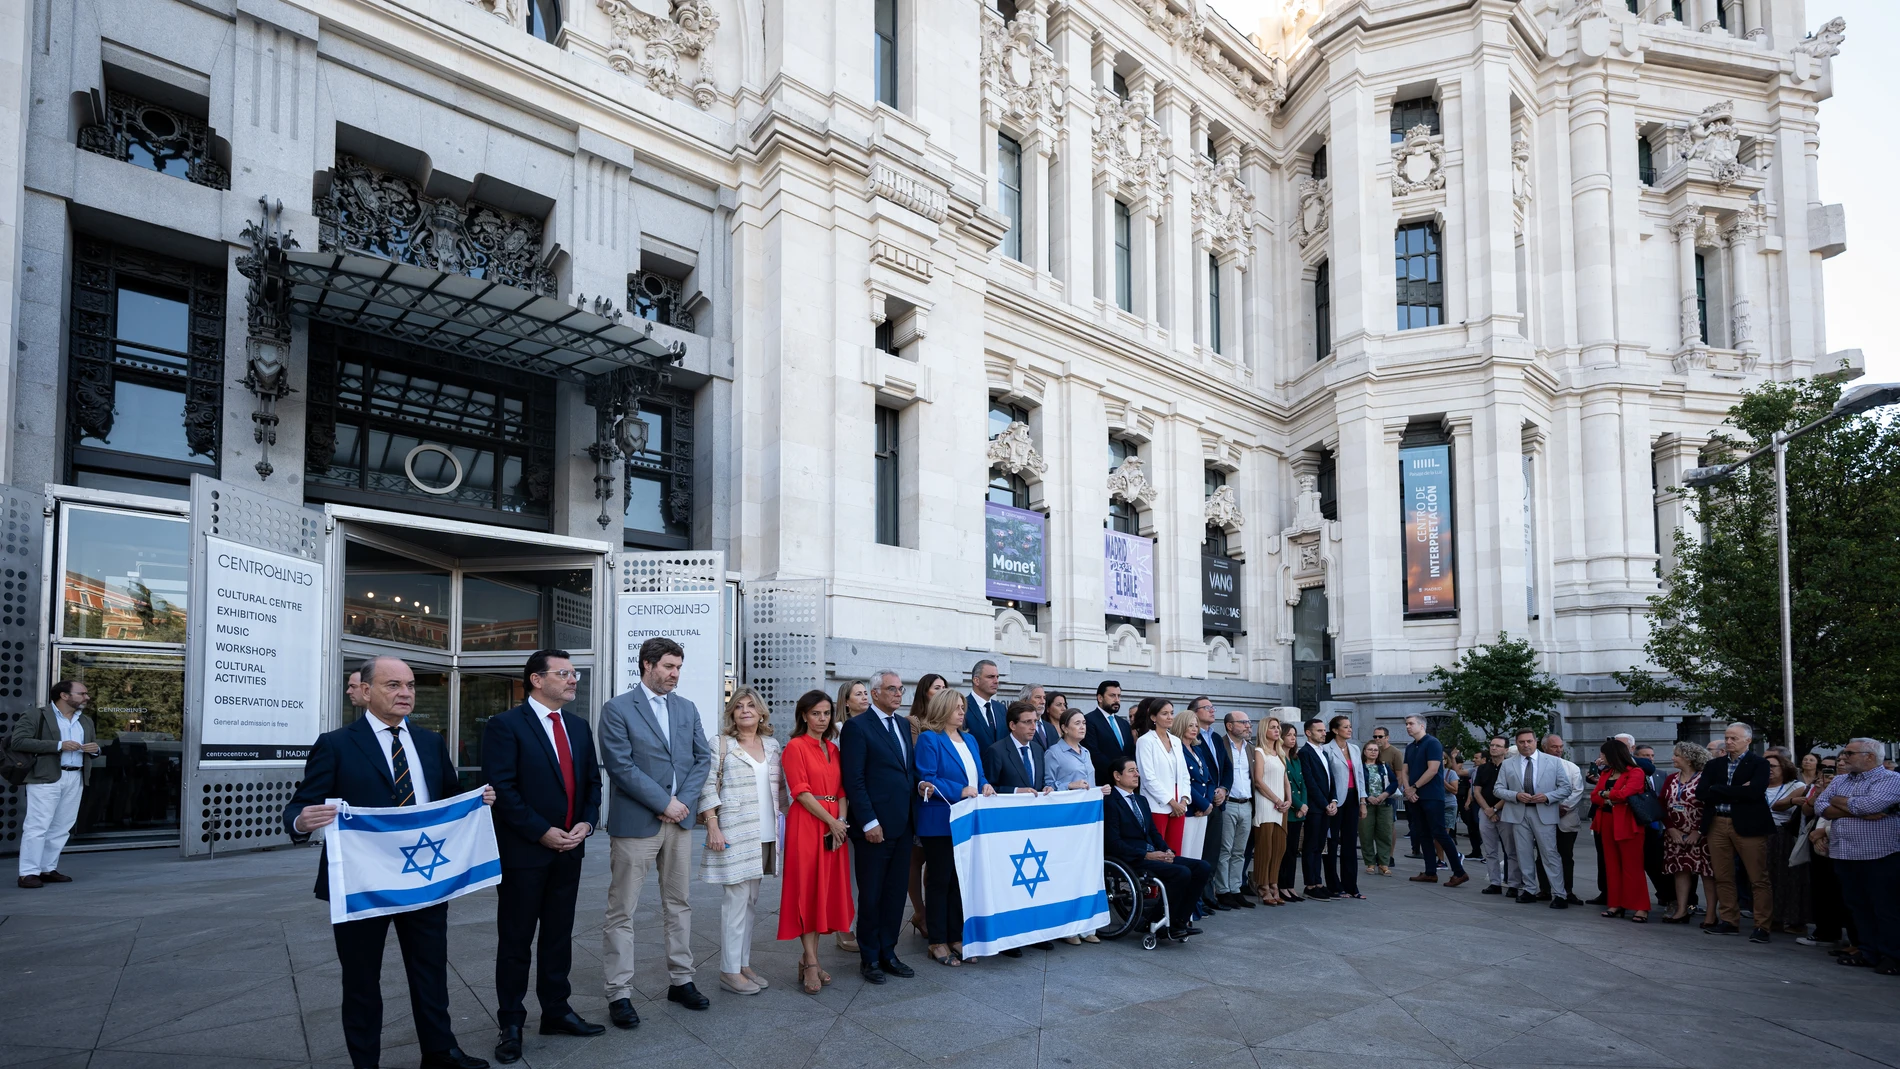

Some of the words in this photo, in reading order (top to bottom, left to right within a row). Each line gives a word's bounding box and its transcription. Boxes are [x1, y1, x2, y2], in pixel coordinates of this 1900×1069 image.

[1416, 486, 1426, 500] DE
[1416, 502, 1427, 542] CENTRO
[1426, 485, 1440, 578] INTERPRETACIÓN
[1105, 534, 1127, 561] MADRID
[992, 553, 1036, 574] Monet
[1116, 572, 1122, 595] EL
[1124, 574, 1138, 598] BAILE
[218, 588, 267, 605] CULTURAL
[269, 598, 302, 612] CENTRE
[217, 606, 277, 624] EXHIBITIONS
[1202, 604, 1240, 618] AUSENCIAS
[216, 624, 250, 636] MUSIC
[216, 642, 277, 658] WORKSHOPS
[215, 660, 265, 674] CULTURAL
[214, 673, 266, 686] ACTIVITIES
[214, 695, 280, 708] OBSERVATION
[282, 700, 304, 709] DECK
